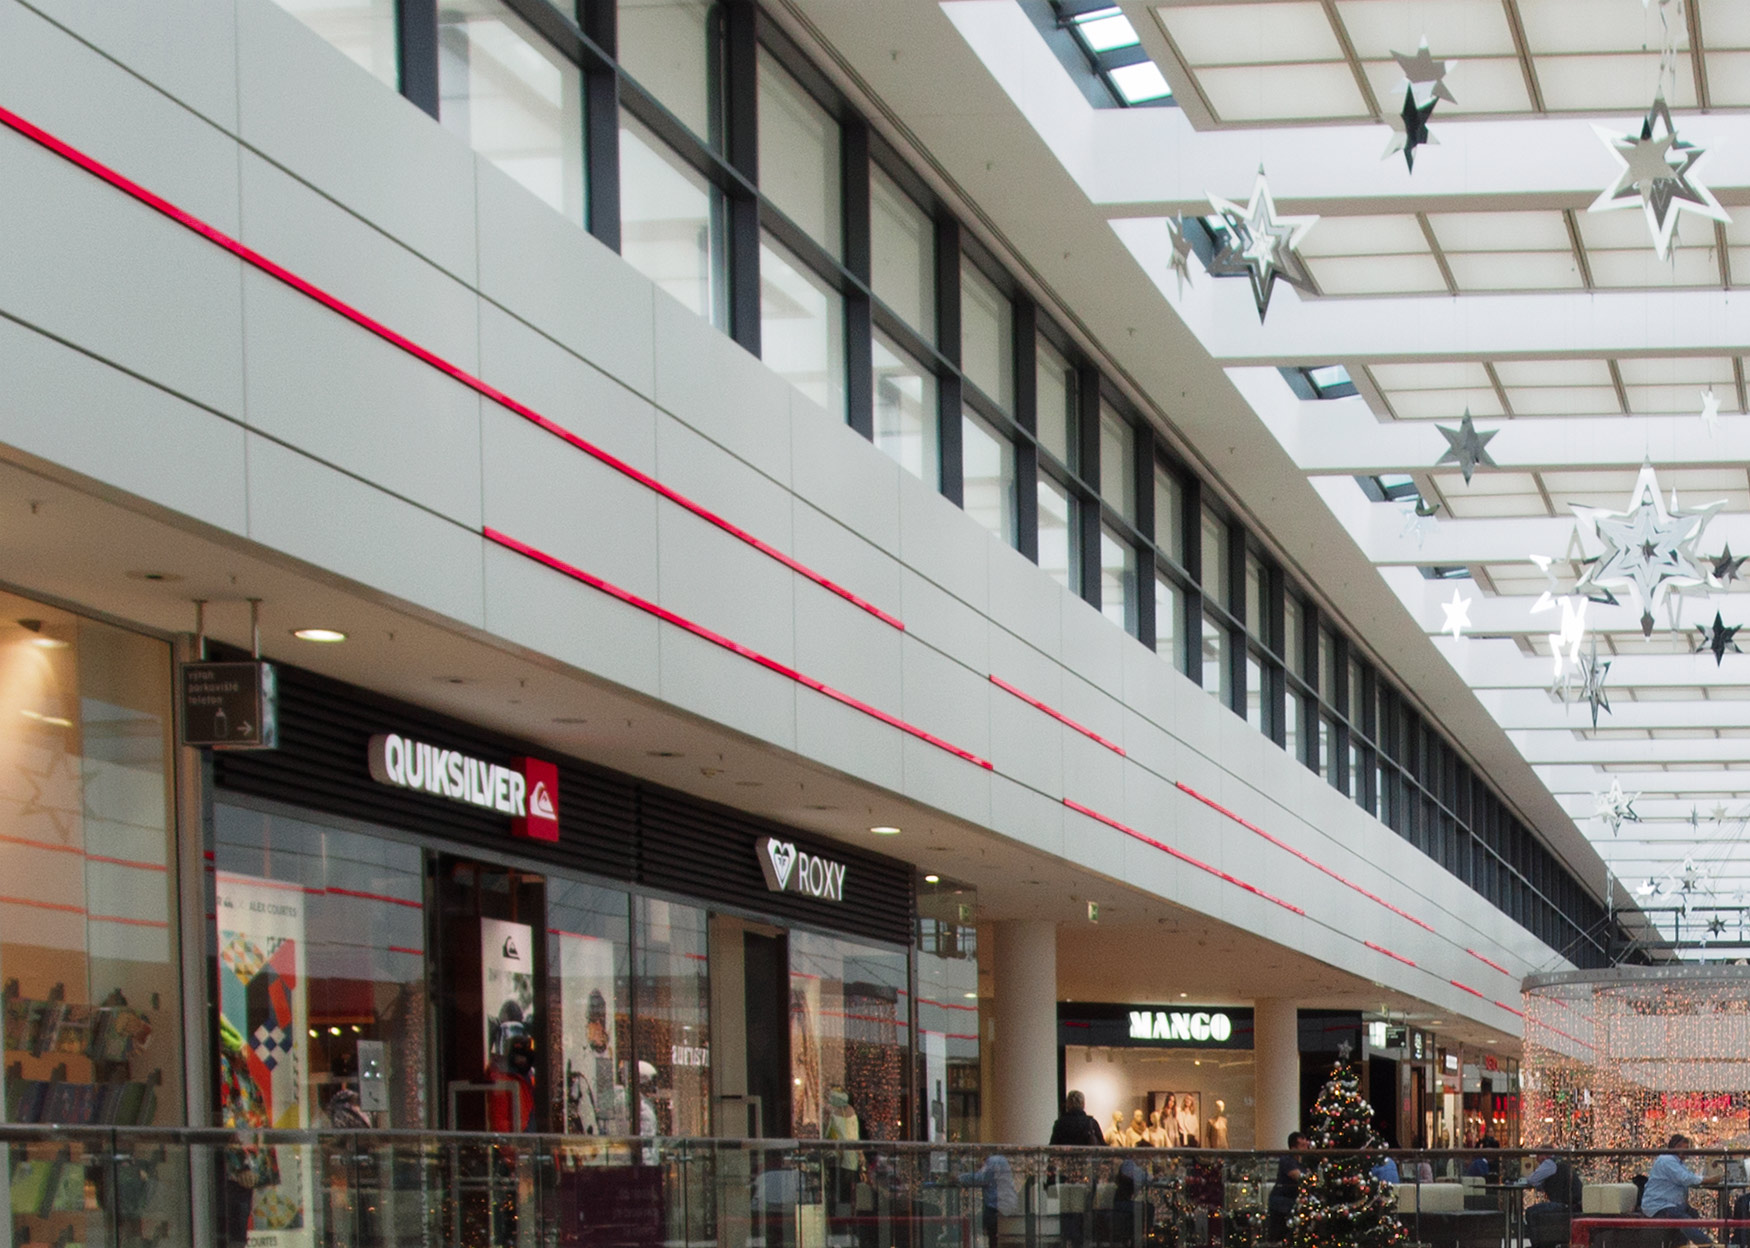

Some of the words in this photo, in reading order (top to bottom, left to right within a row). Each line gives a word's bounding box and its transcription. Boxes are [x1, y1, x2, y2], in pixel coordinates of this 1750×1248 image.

[385, 733, 527, 818] QUIKSILVER
[798, 851, 846, 901] ROXY
[1129, 1011, 1232, 1042] MANGO
